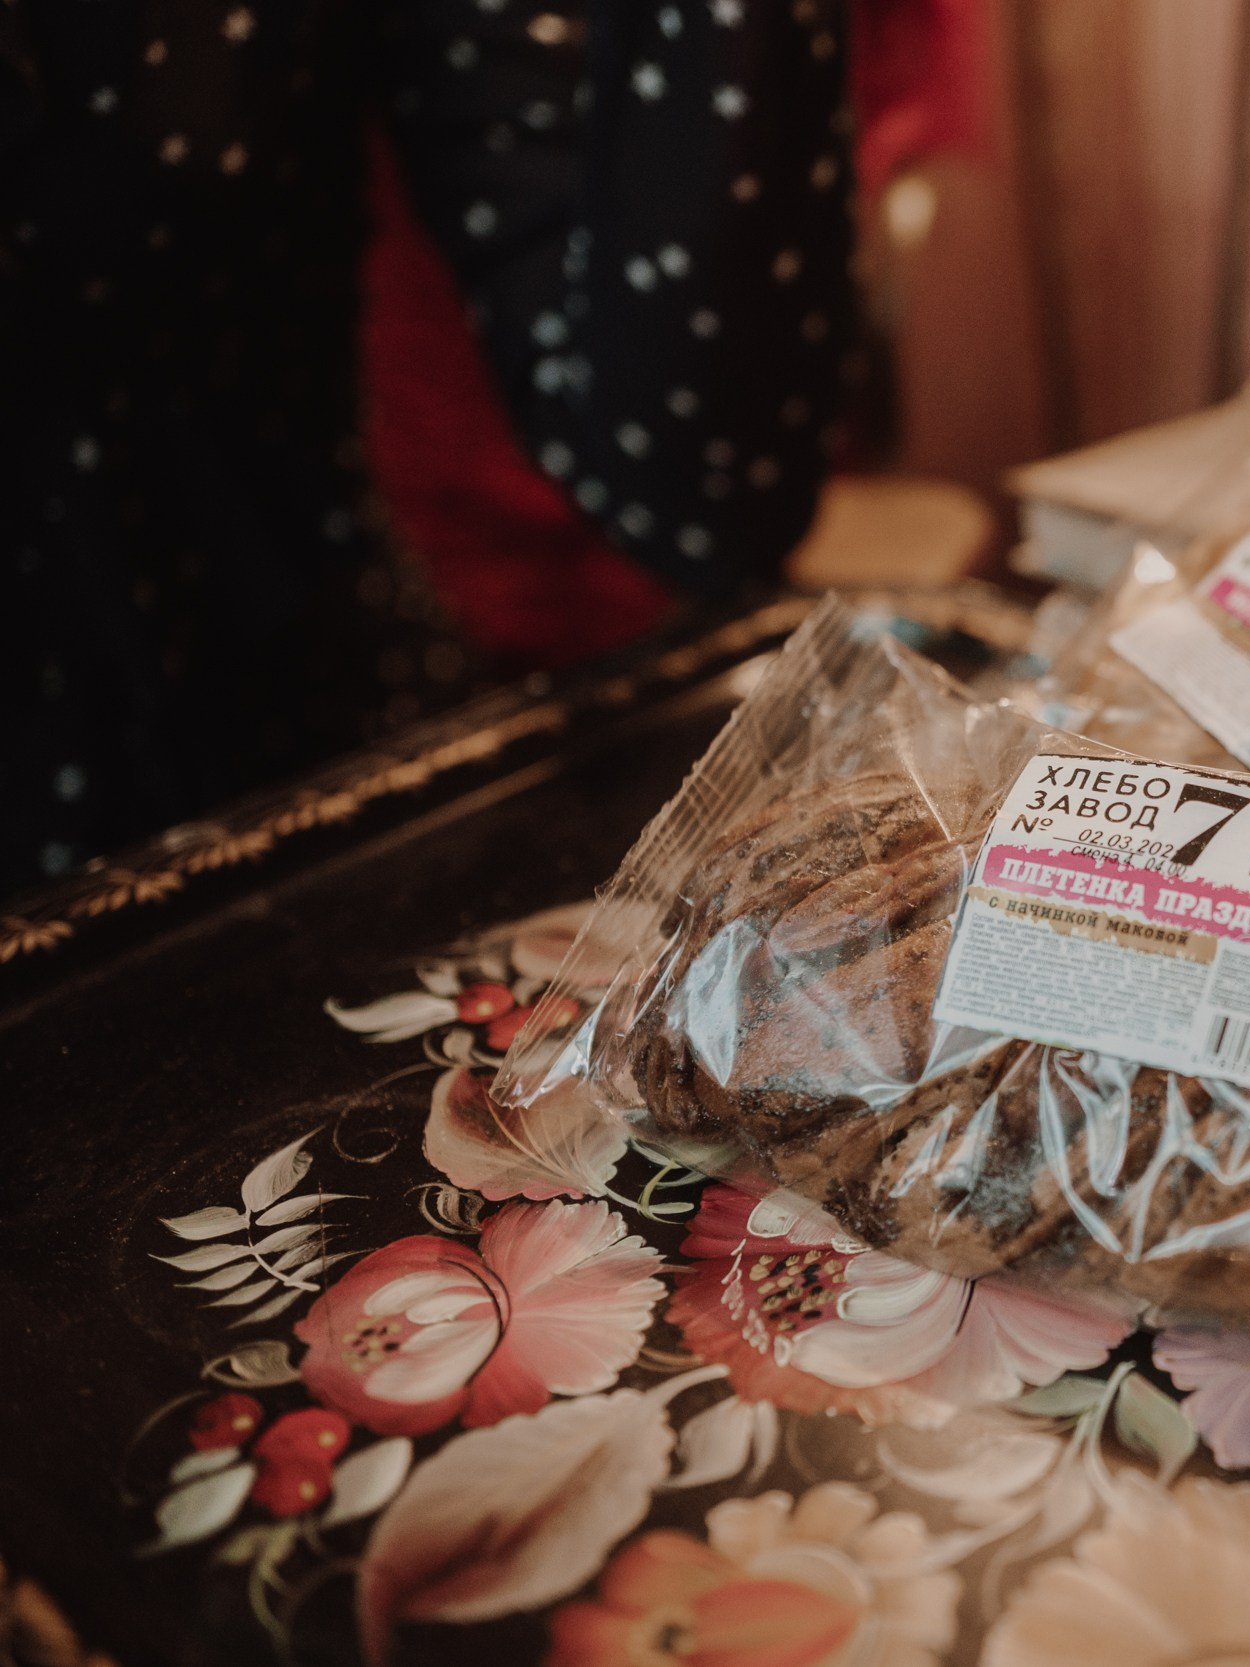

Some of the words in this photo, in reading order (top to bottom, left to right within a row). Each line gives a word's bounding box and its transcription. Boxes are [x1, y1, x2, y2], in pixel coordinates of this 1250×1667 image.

[1038, 765, 1171, 799] ХЛЕБО
[1025, 790, 1159, 832] ЗАВОД
[1078, 828, 1176, 859] 02.03.202
[999, 857, 1145, 908] ПЛЕТЕНКА
[989, 896, 998, 909] с
[1006, 899, 1099, 927] начинкой
[1106, 918, 1189, 945] маковой
